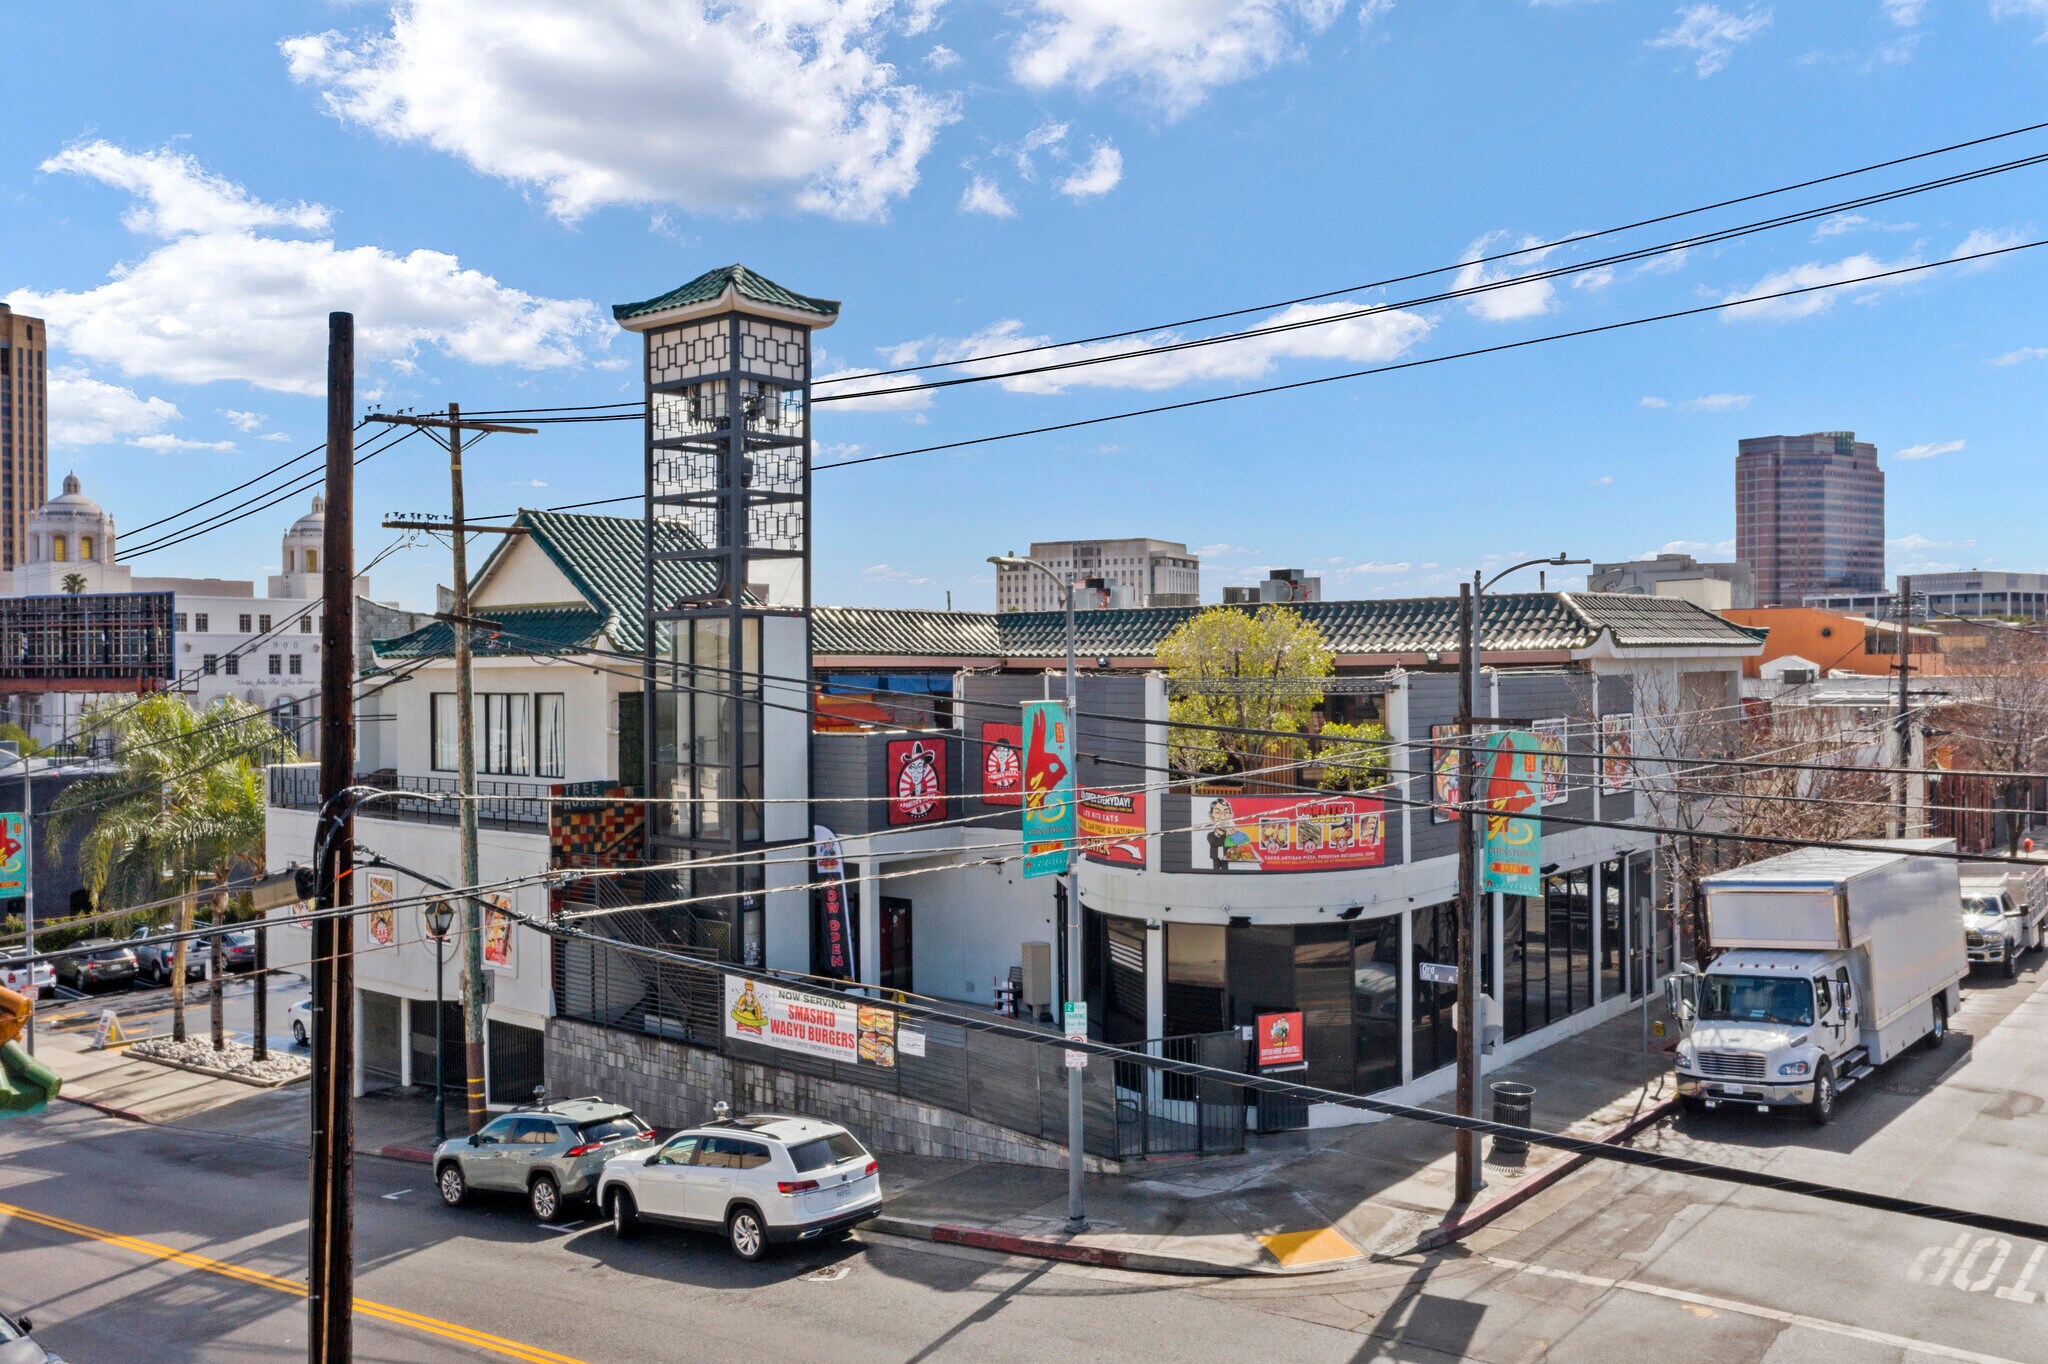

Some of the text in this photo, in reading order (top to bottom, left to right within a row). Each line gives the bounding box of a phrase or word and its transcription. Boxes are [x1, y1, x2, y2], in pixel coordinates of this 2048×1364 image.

[273, 641, 298, 649] 900
[564, 782, 598, 796] TREE
[1102, 814, 1119, 823] EATS
[1027, 825, 1069, 837] CHINATOWN
[1487, 847, 1536, 858] CHINATOWN
[829, 919, 843, 967] OPEN
[1422, 964, 1435, 975] Ord
[778, 990, 846, 1010] NOW SERVING
[788, 1004, 836, 1028] SMASHED
[770, 1018, 855, 1050] WAGYU BURGERS
[1907, 1231, 2048, 1304] TOP
